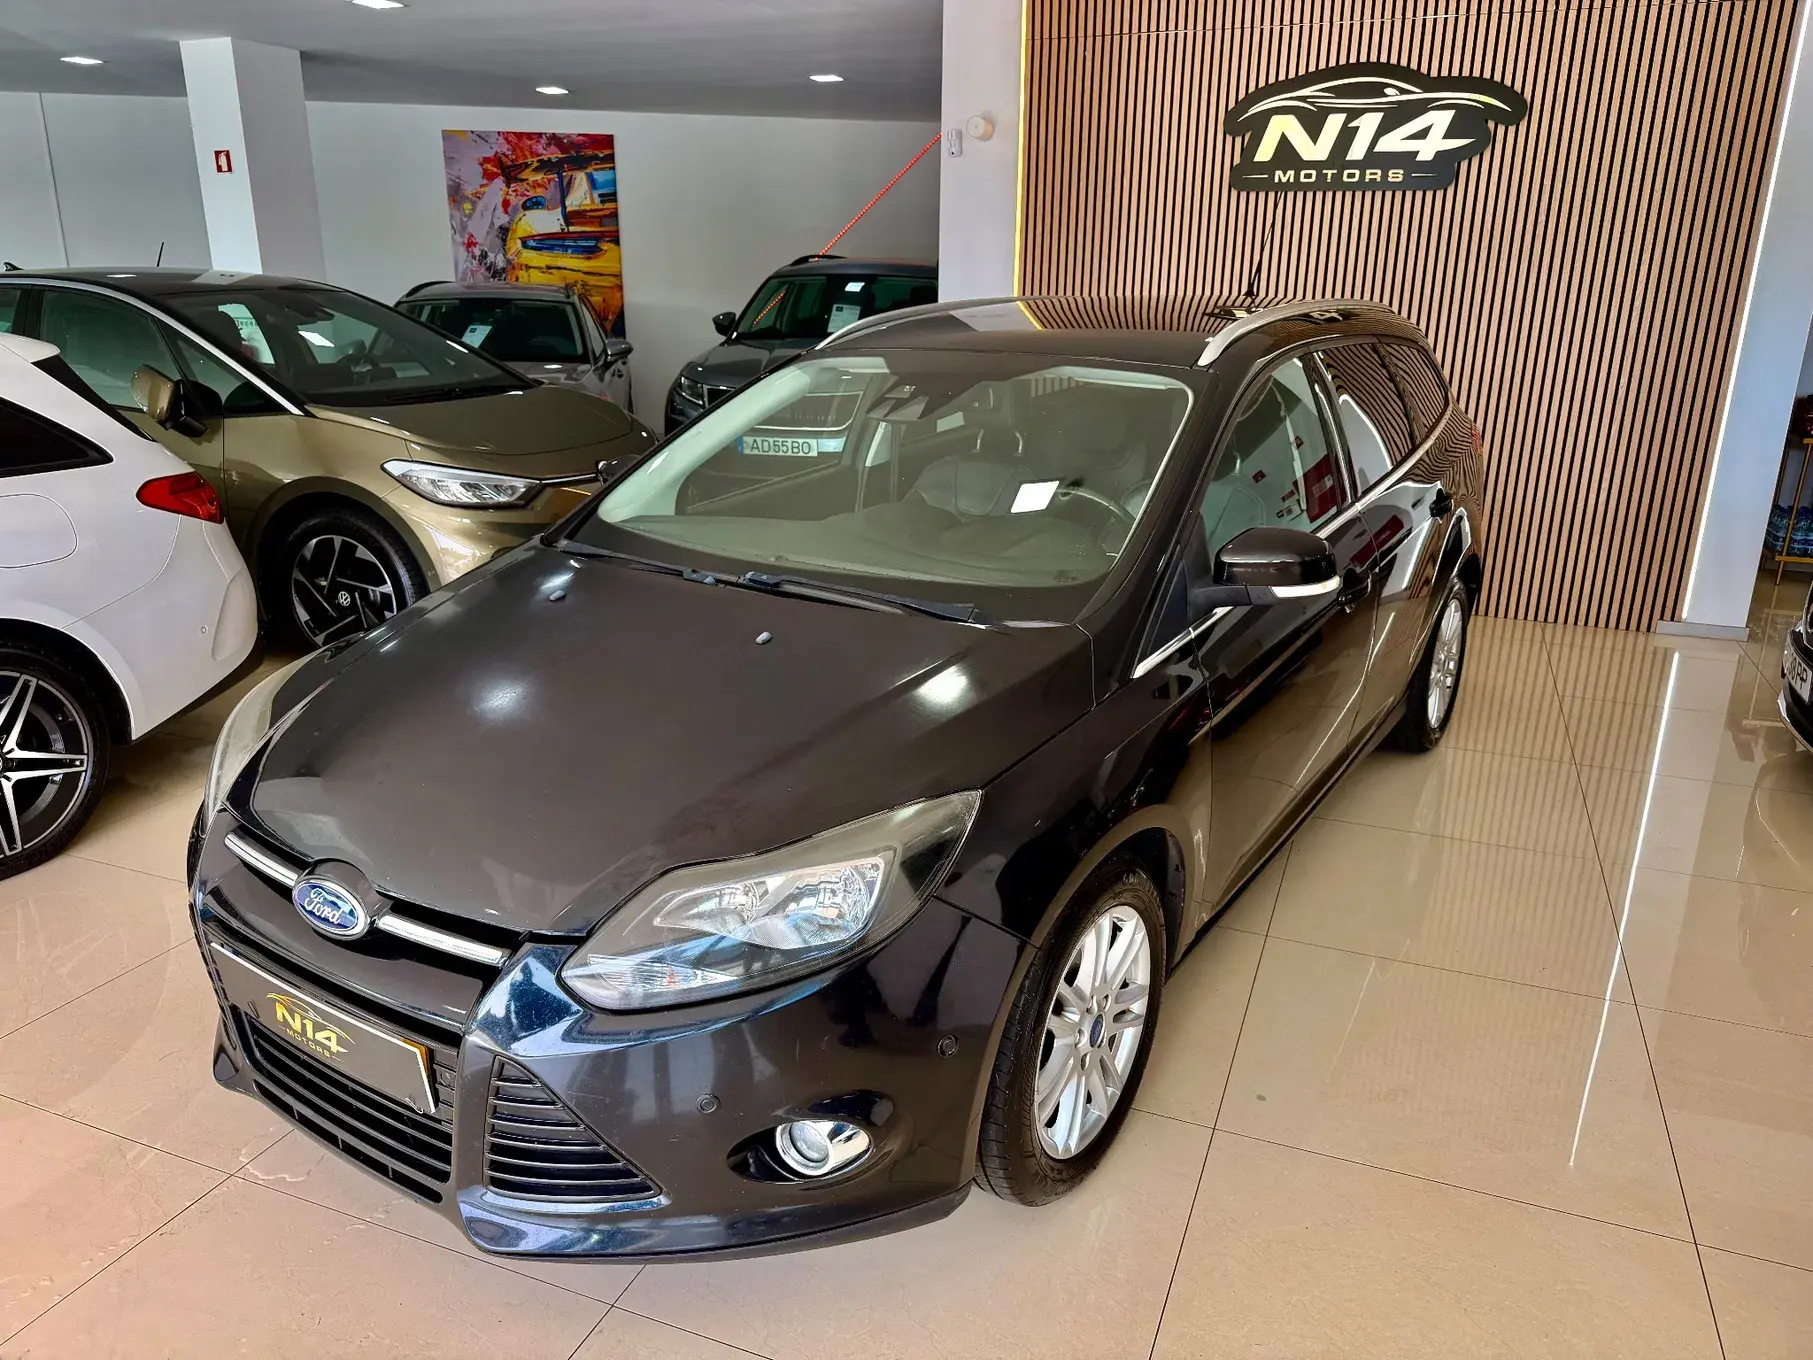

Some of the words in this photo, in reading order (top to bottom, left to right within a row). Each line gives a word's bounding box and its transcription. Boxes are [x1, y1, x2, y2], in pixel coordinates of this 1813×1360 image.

[1253, 109, 1476, 162] N14
[1274, 169, 1404, 183] MOTORS
[750, 438, 811, 455] AD55BO
[304, 887, 343, 924] Ford
[275, 1001, 349, 1053] N14
